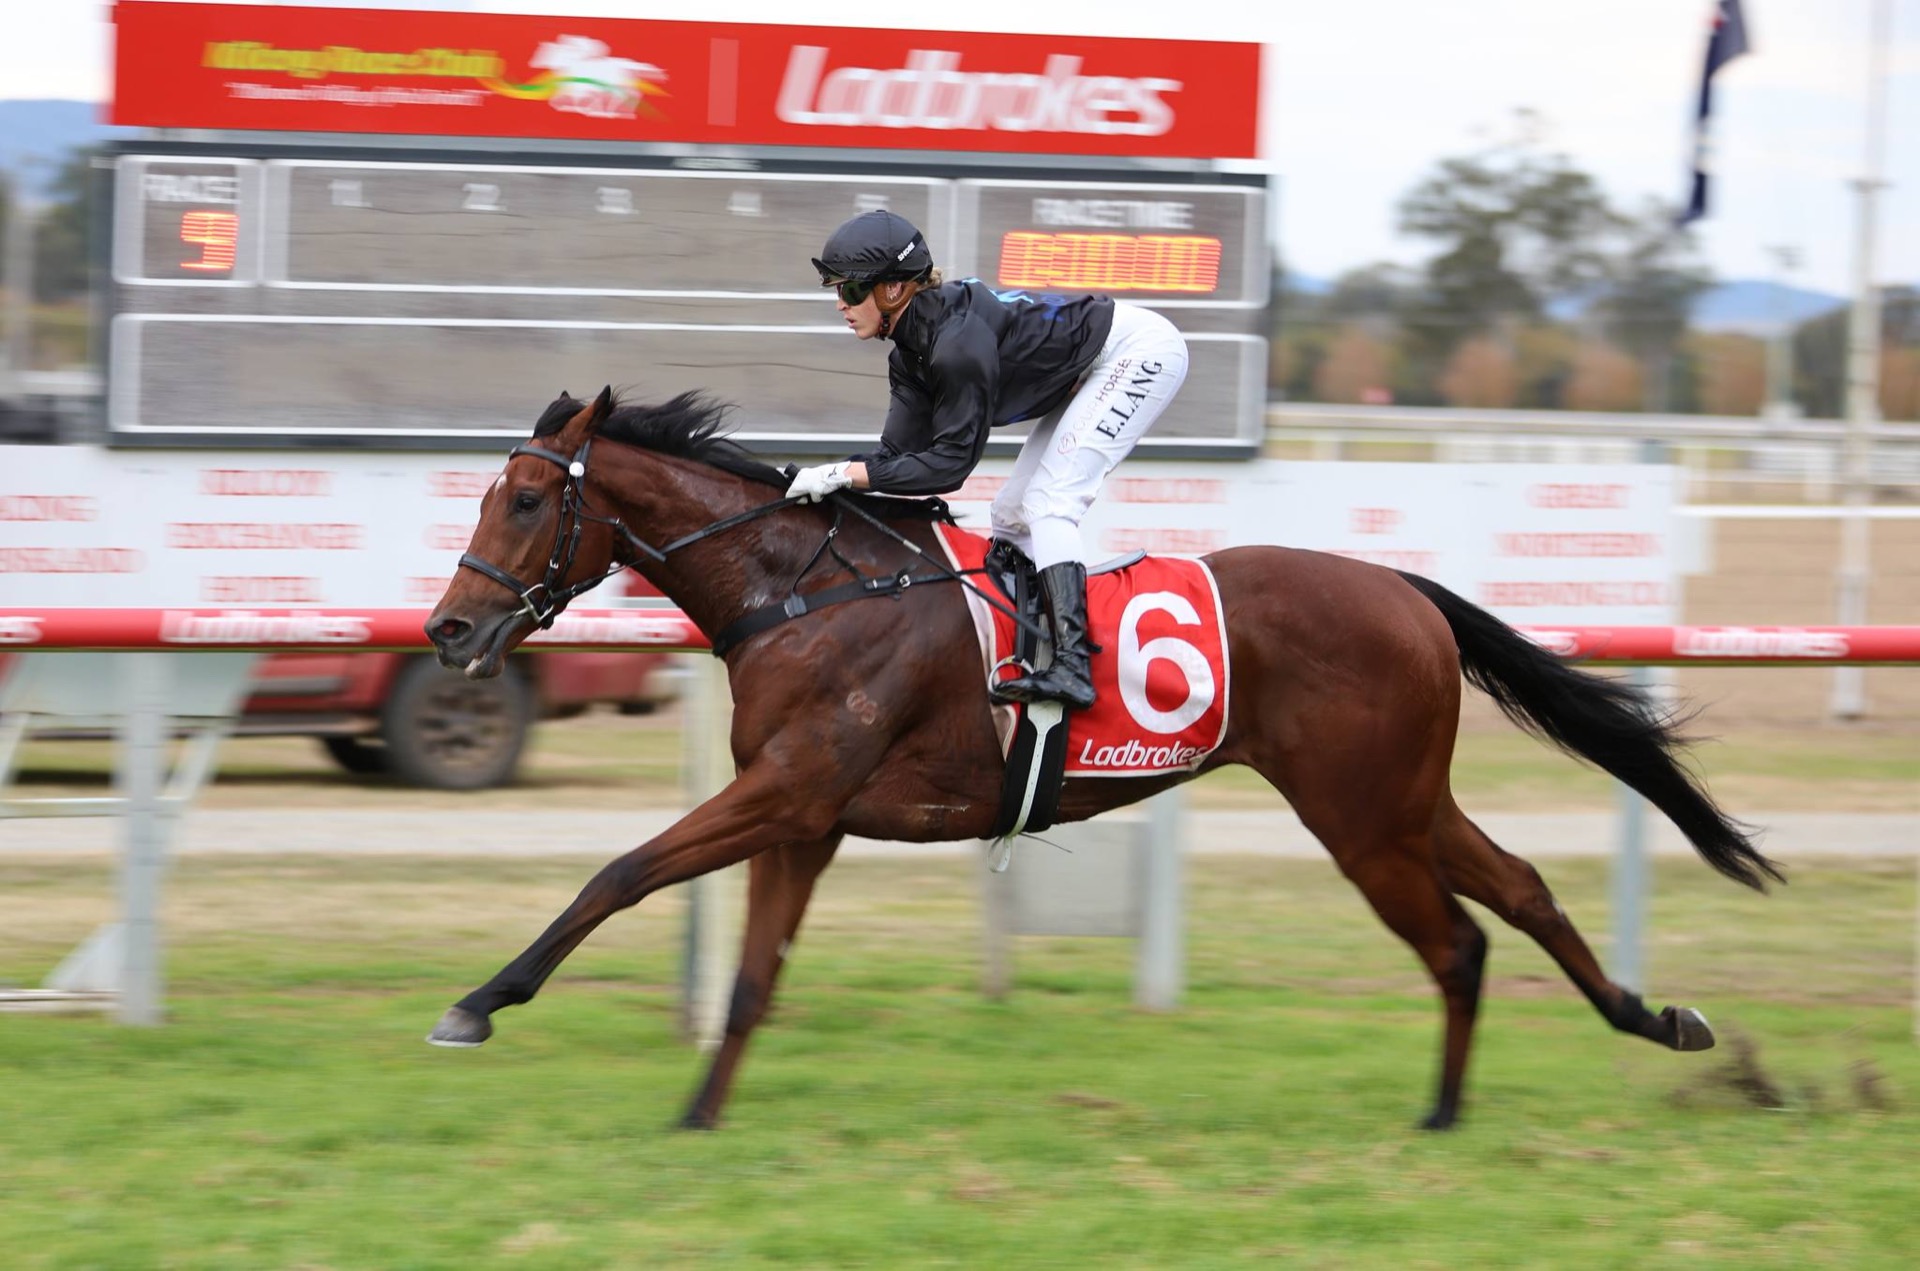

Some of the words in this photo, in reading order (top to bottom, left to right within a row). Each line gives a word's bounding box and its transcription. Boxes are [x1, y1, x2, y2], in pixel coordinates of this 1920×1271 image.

[775, 44, 1183, 137] Ladbrokes
[1096, 359, 1162, 440] E.LANG
[158, 610, 374, 643] Ladbrokes
[1117, 590, 1215, 734] 6
